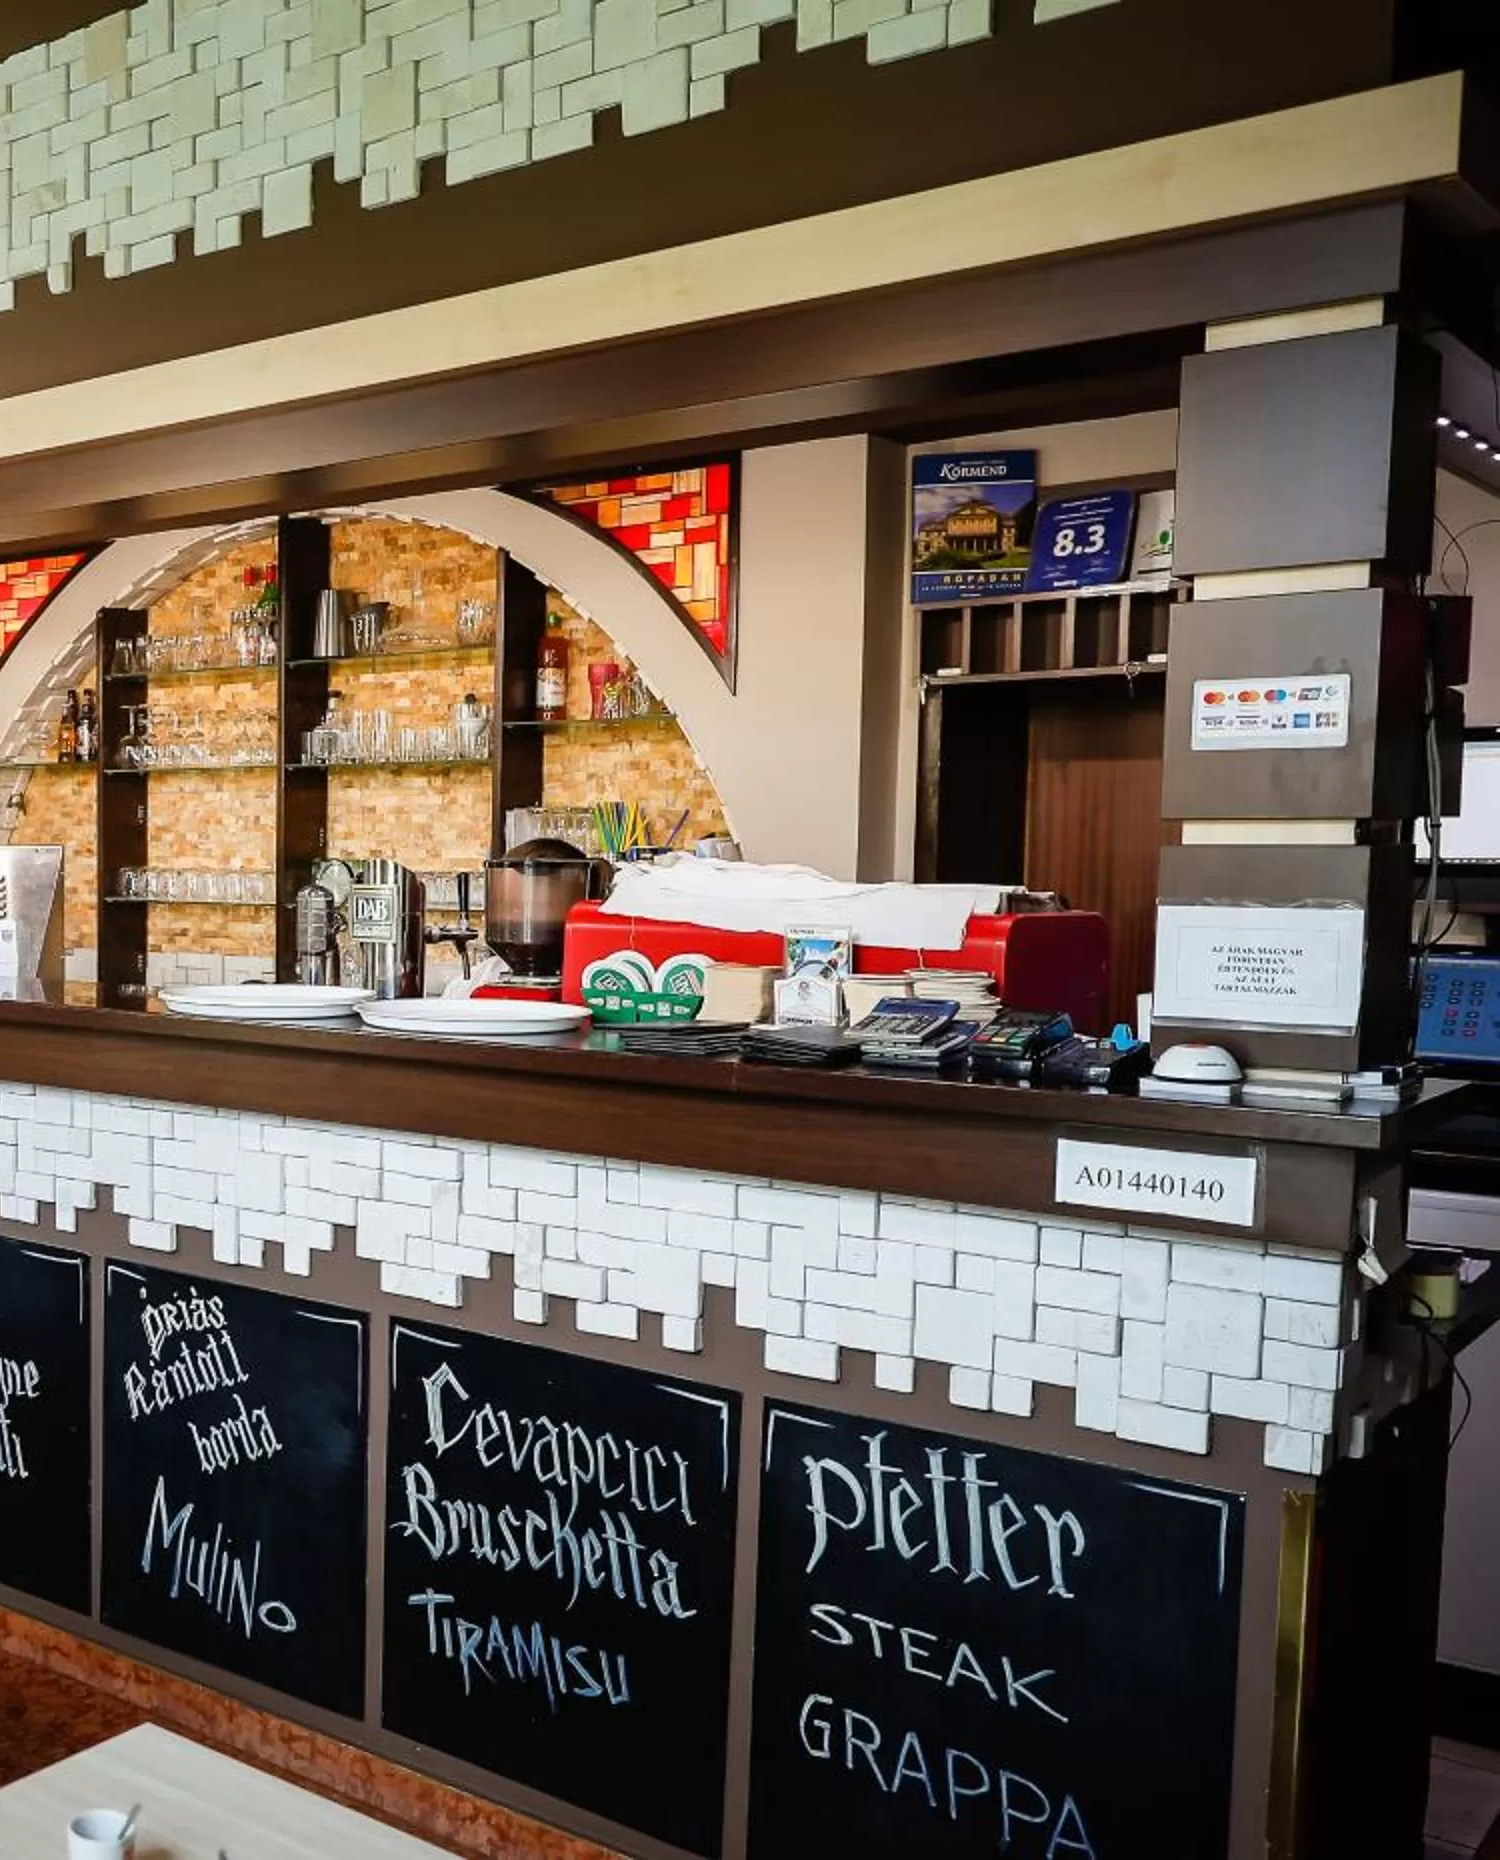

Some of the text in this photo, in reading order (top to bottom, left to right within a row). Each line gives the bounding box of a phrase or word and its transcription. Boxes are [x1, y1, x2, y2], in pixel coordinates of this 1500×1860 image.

[1053, 524, 1105, 557] 8.3
[358, 898, 389, 921] DAB
[1075, 1165, 1225, 1202] A01440140
[422, 1362, 697, 1526] Cevapcici
[408, 1588, 630, 1713] TIRAMISU
[810, 1603, 1069, 1723] STEAK
[800, 1694, 1096, 1860] GRAPPA
